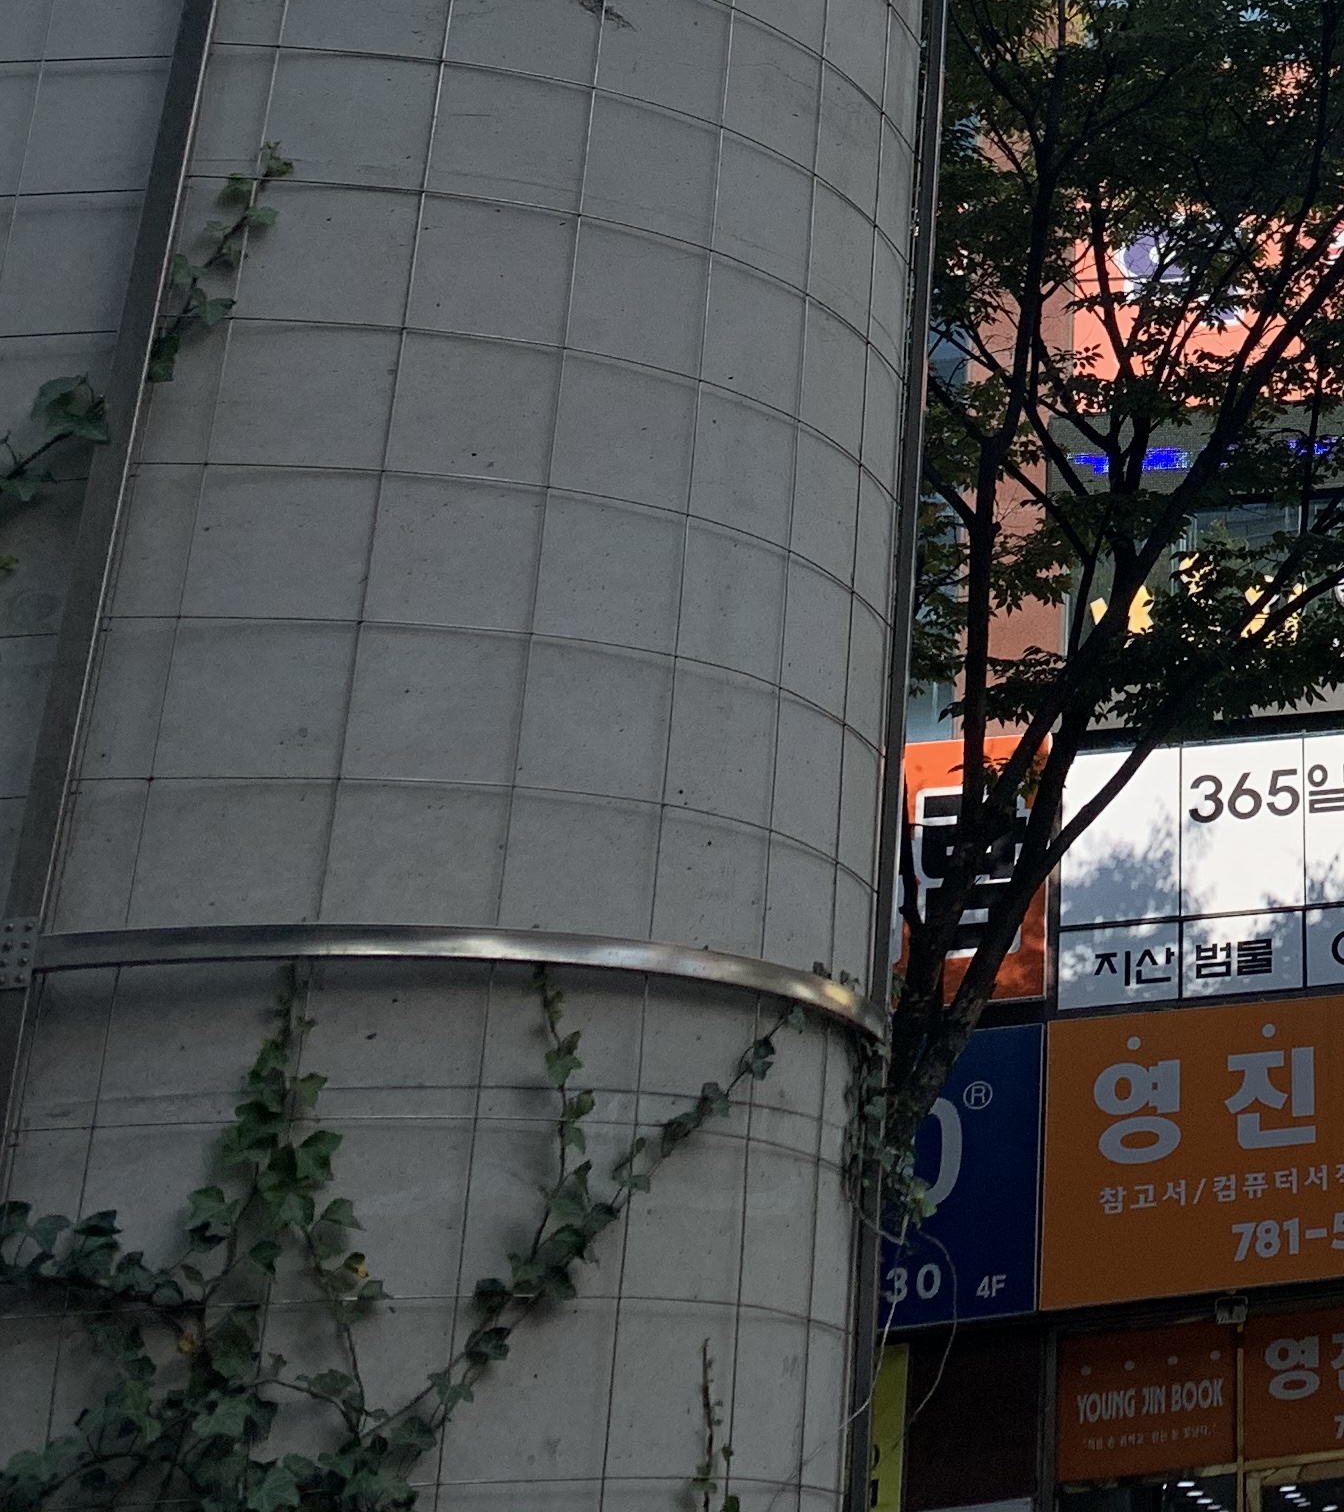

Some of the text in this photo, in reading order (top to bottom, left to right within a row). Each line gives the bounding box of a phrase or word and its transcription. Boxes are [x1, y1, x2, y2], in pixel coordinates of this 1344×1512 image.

[1094, 947, 1177, 988] 지산
[1195, 937, 1274, 981] 범물
[975, 1274, 1007, 1300] 4F
[1076, 1377, 1224, 1424] YOUNG JIN BOOK
